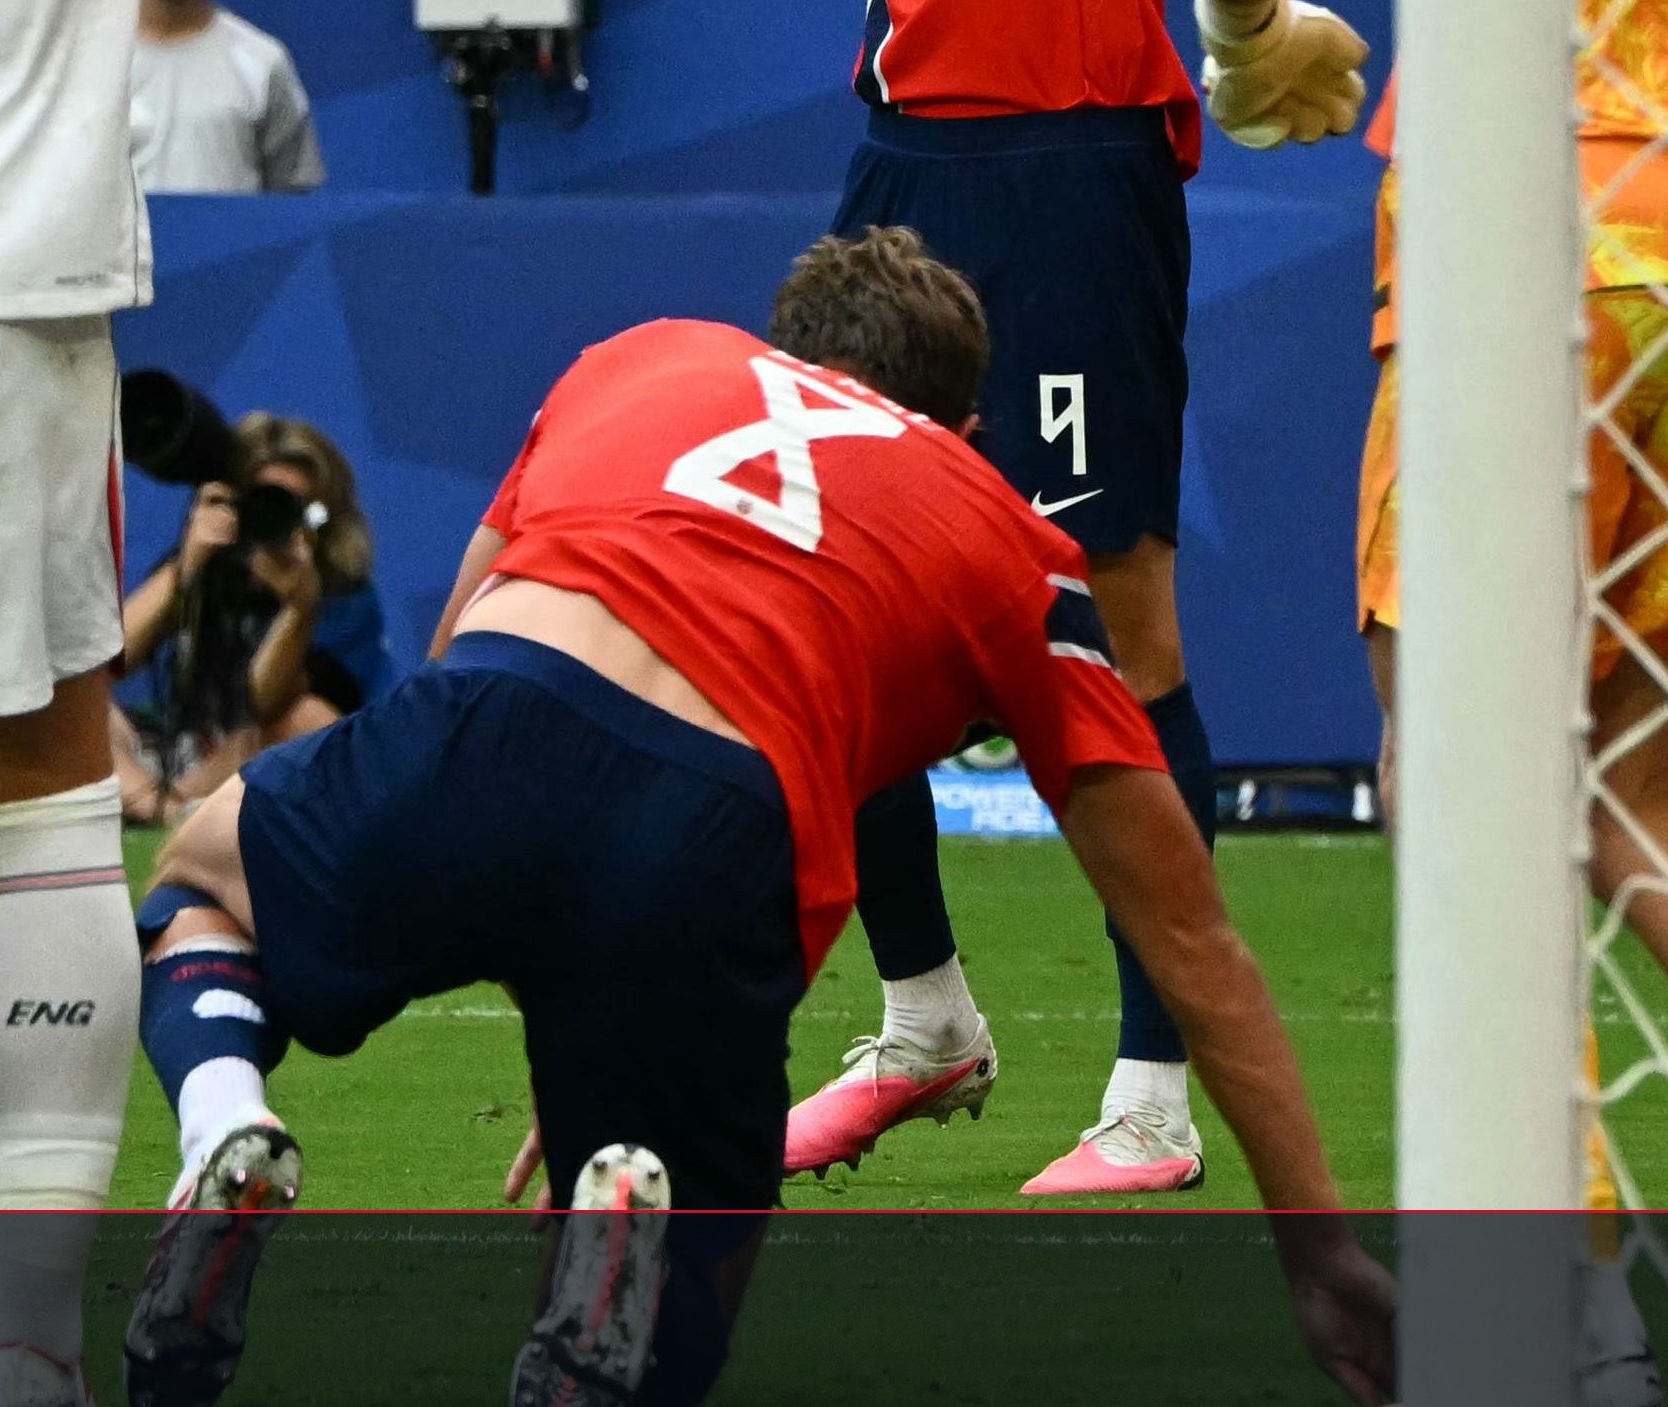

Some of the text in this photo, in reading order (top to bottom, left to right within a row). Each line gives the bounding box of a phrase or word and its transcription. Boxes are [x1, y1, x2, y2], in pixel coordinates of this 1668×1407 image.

[662, 355, 908, 554] 8
[1040, 373, 1088, 476] 9
[7, 998, 95, 1026] ENG
